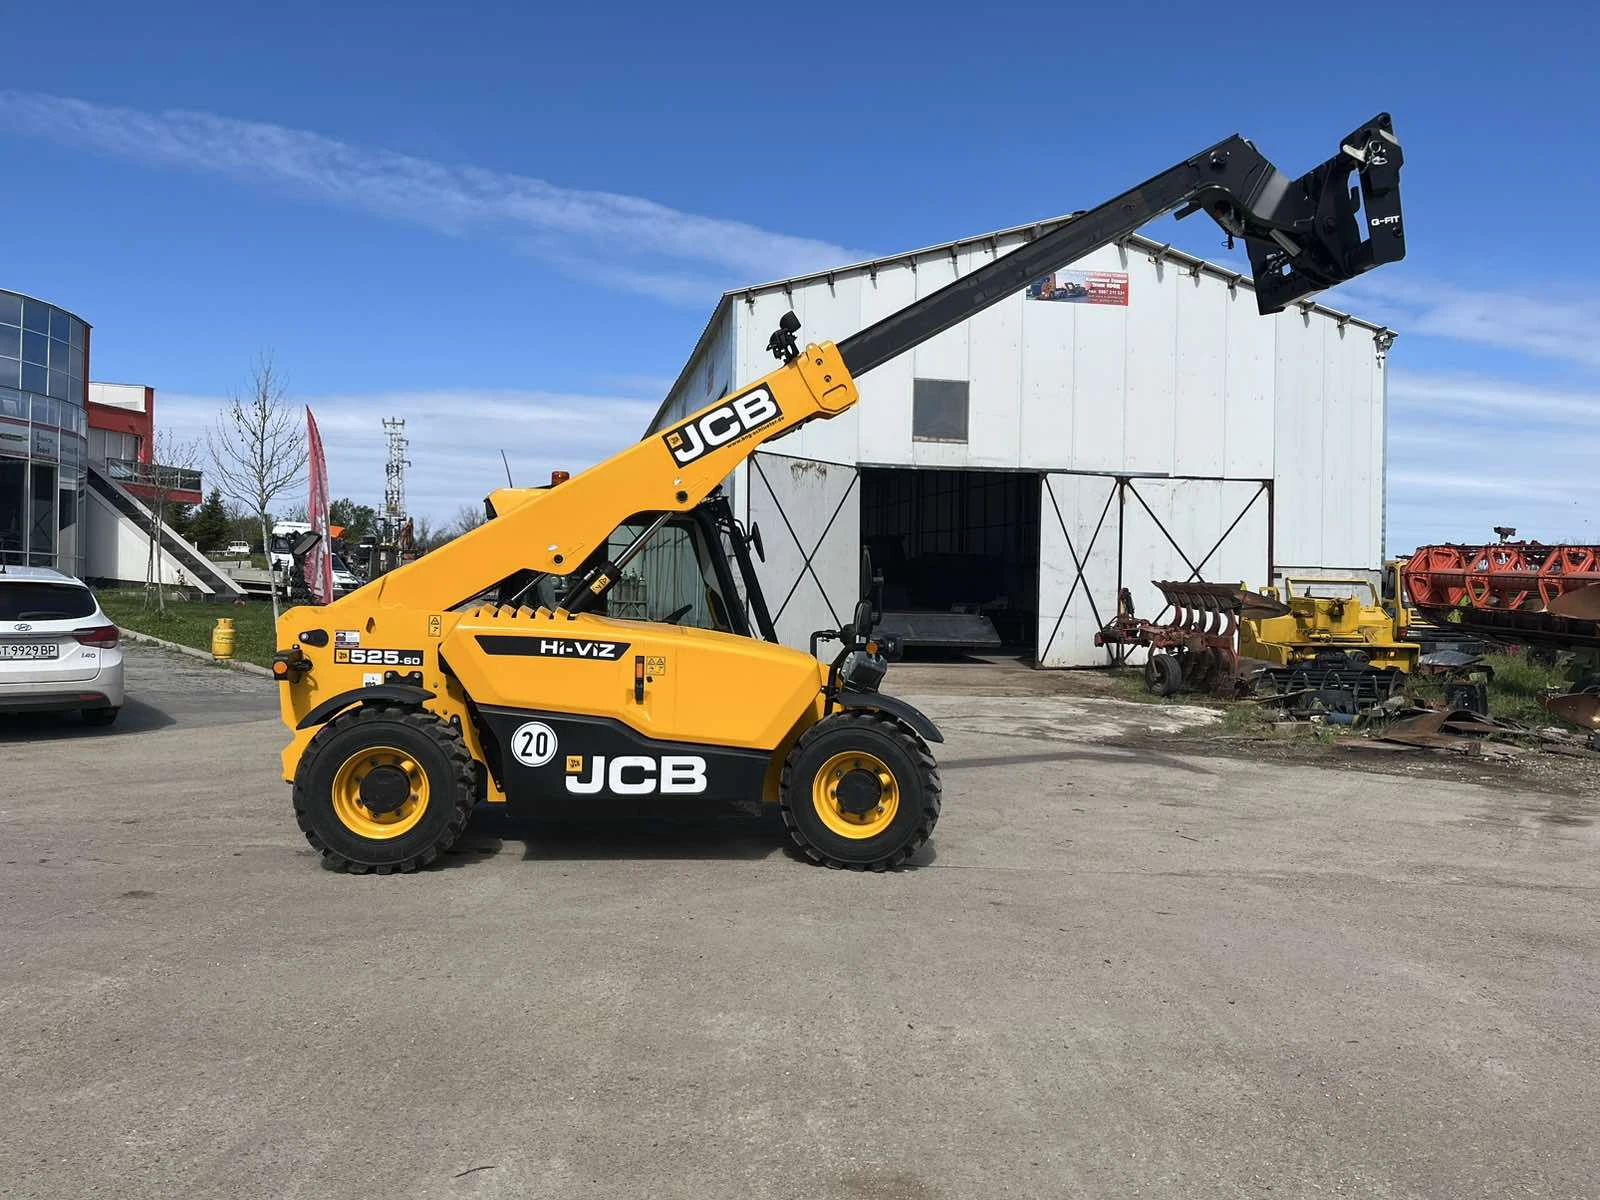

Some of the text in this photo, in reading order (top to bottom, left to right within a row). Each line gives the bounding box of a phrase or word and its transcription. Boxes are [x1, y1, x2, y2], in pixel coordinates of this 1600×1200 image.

[1371, 215, 1400, 226] Q-FIT
[674, 388, 777, 462] JCB
[521, 731, 548, 757] 20
[565, 755, 708, 795] JCB
